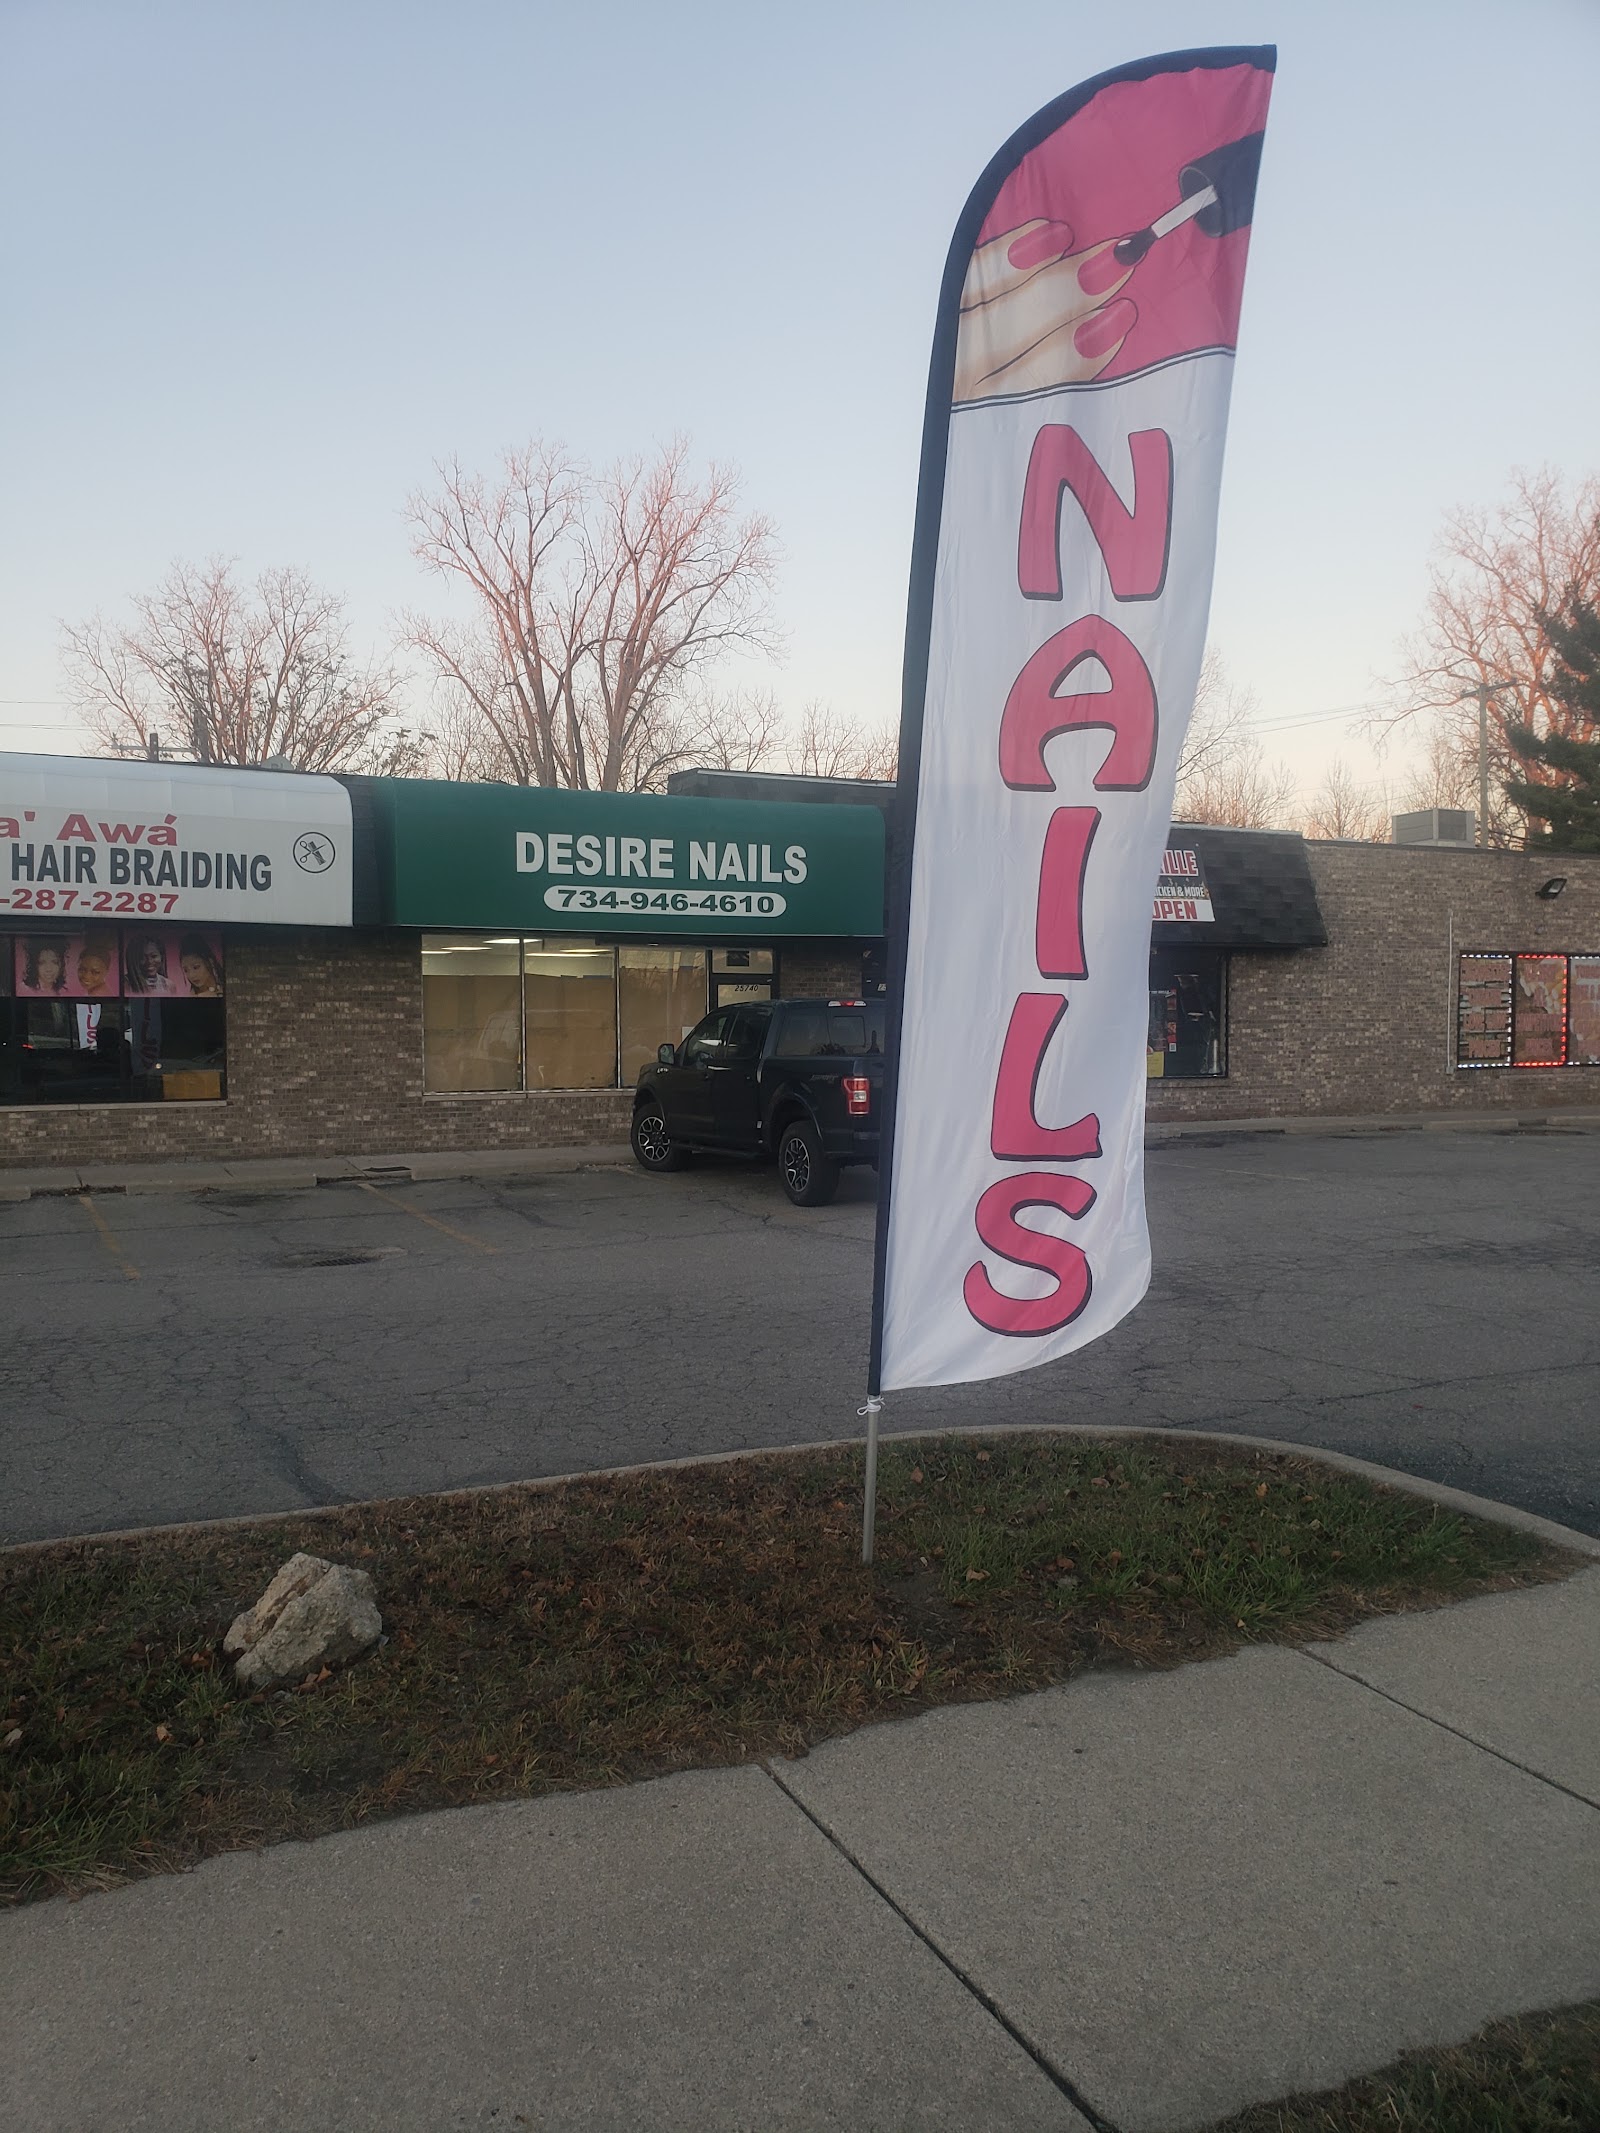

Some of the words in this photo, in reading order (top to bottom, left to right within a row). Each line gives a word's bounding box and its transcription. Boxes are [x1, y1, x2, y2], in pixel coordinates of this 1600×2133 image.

[56, 813, 178, 846] Awá
[11, 843, 98, 884] HAIR
[110, 847, 272, 892] BRAIDING
[515, 831, 675, 879] DESIRE
[689, 841, 808, 885] NAILS
[1160, 850, 1199, 876] ILLE
[963, 423, 1173, 1337] NAILS
[1184, 886, 1204, 897] MORE
[556, 888, 775, 914] 734-946-4610
